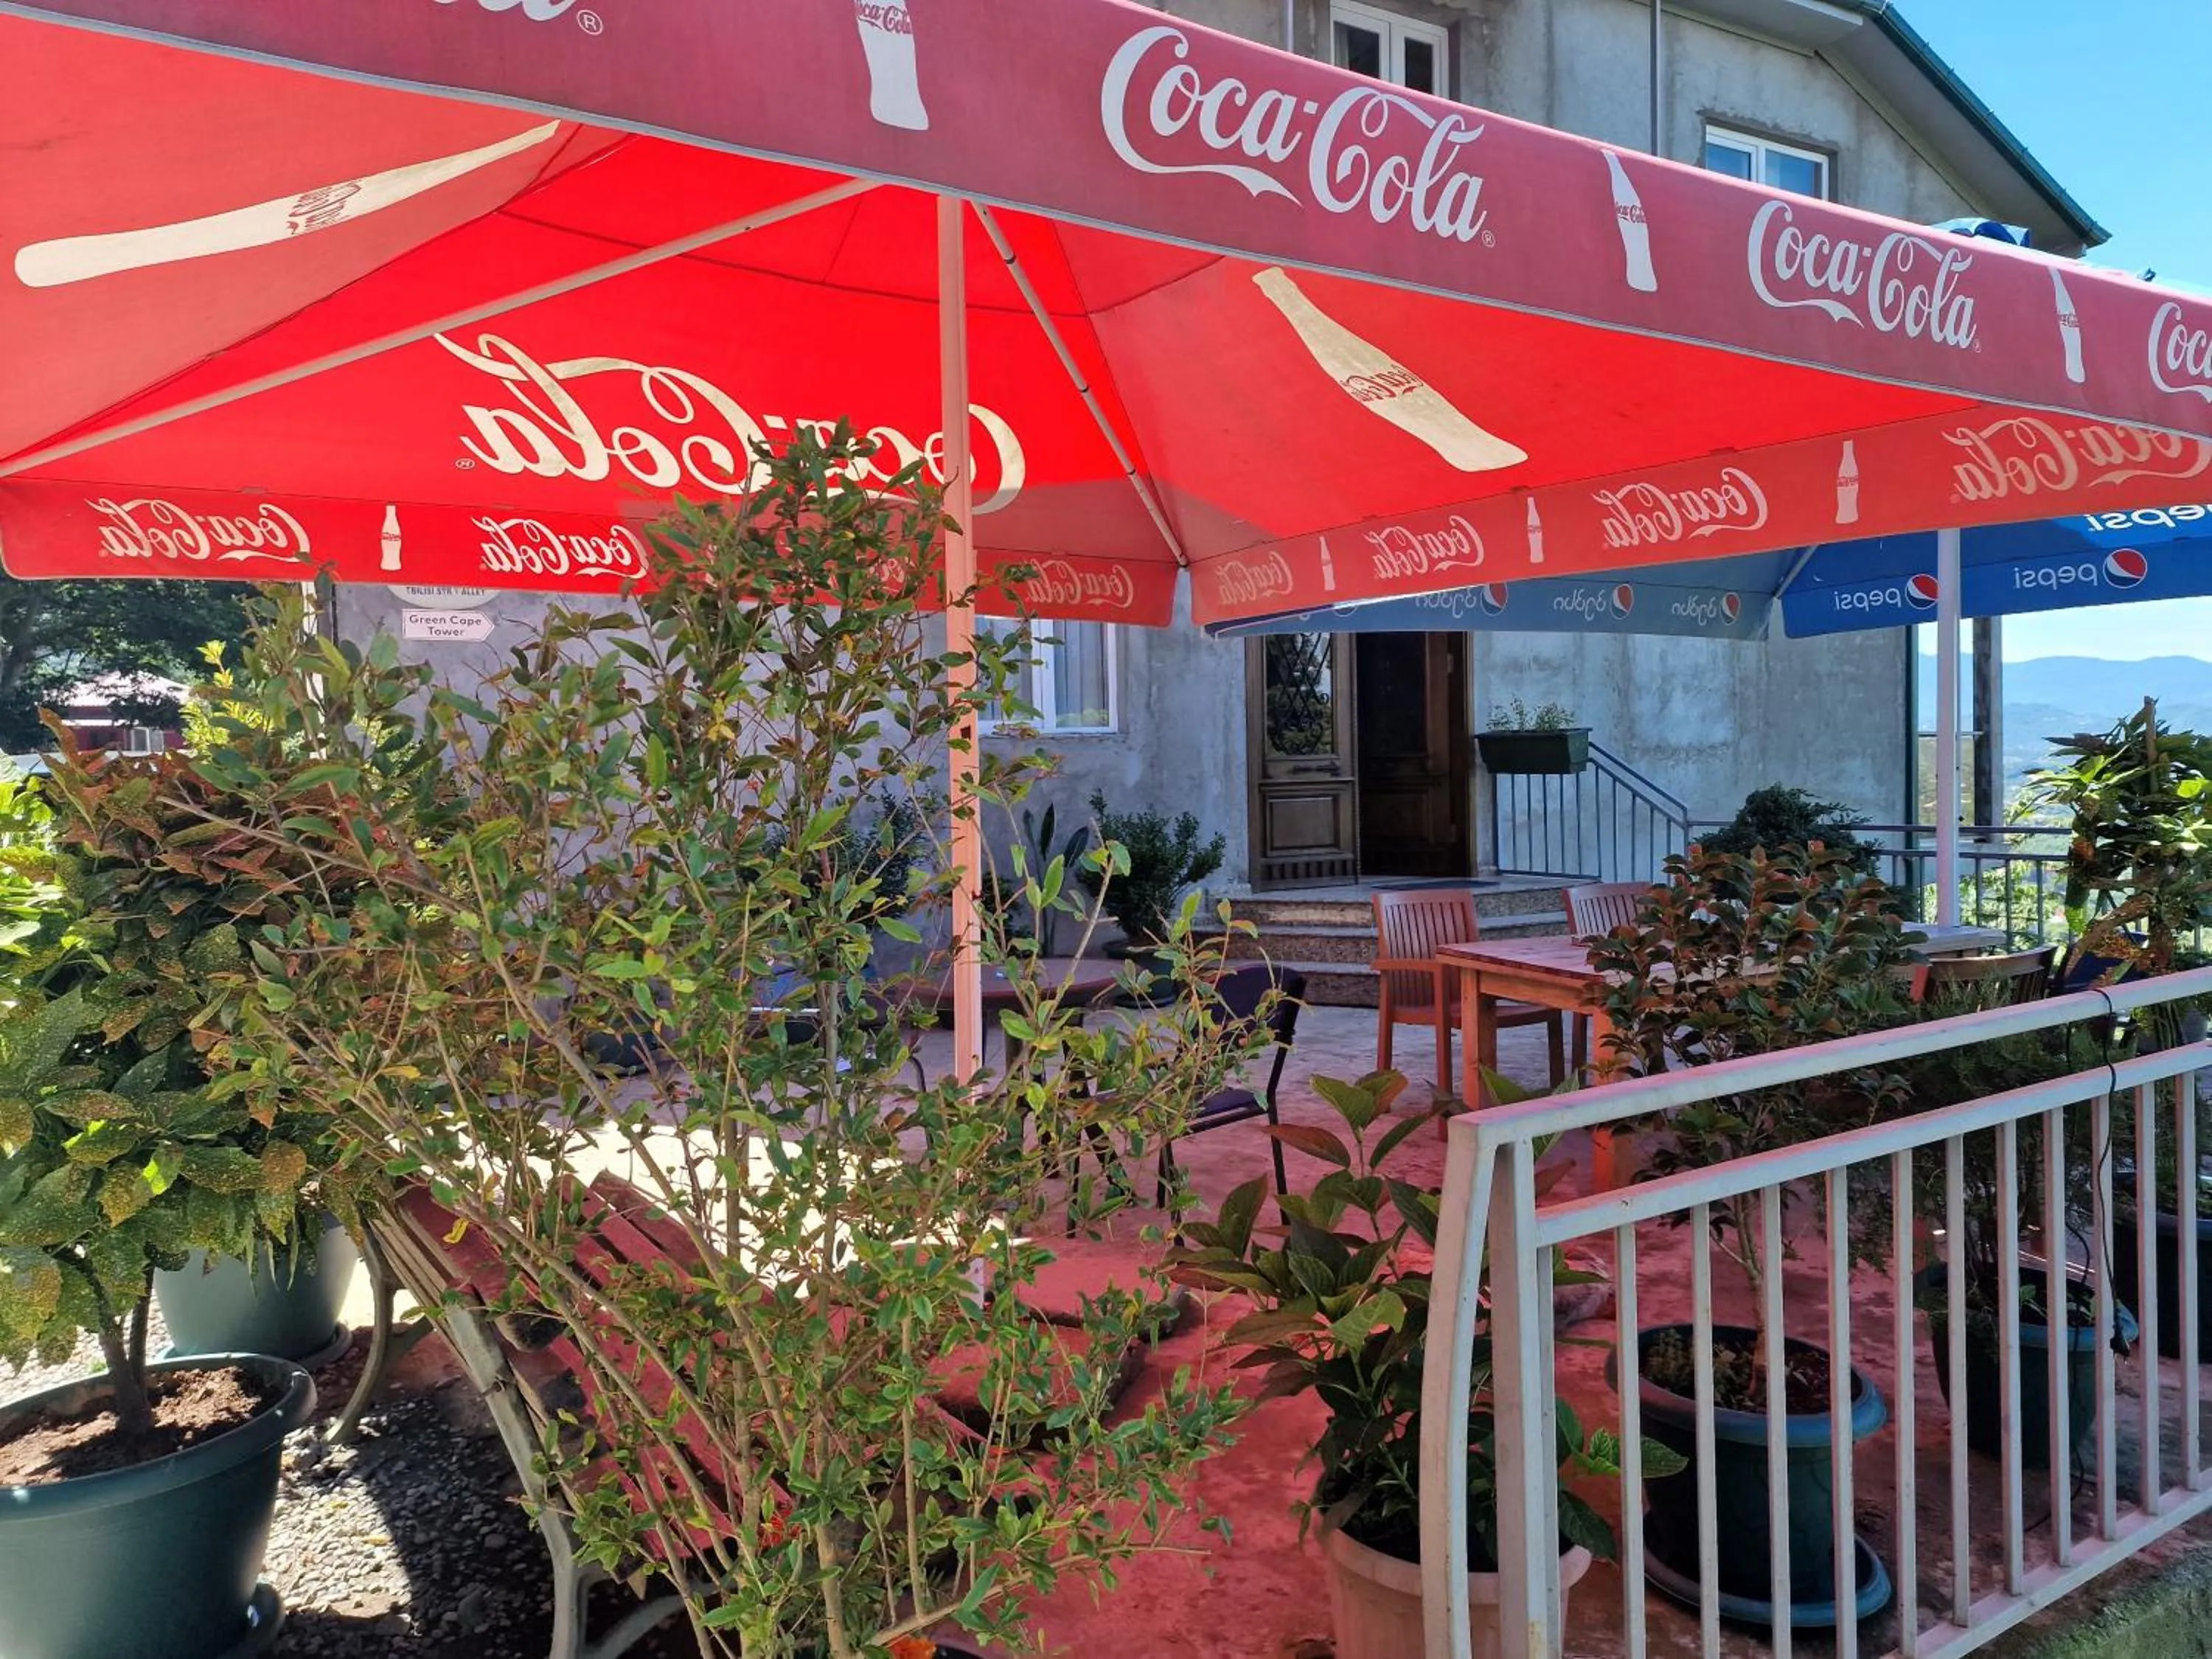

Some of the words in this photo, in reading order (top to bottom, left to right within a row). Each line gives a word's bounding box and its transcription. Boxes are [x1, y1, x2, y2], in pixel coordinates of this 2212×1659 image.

[1101, 26, 1488, 243] Coca-Cola
[1747, 200, 1979, 349] Coca-Cola
[2148, 302, 2212, 403] Coc
[409, 614, 446, 625] Green
[450, 615, 481, 627] Cape
[428, 627, 465, 636] Tower
